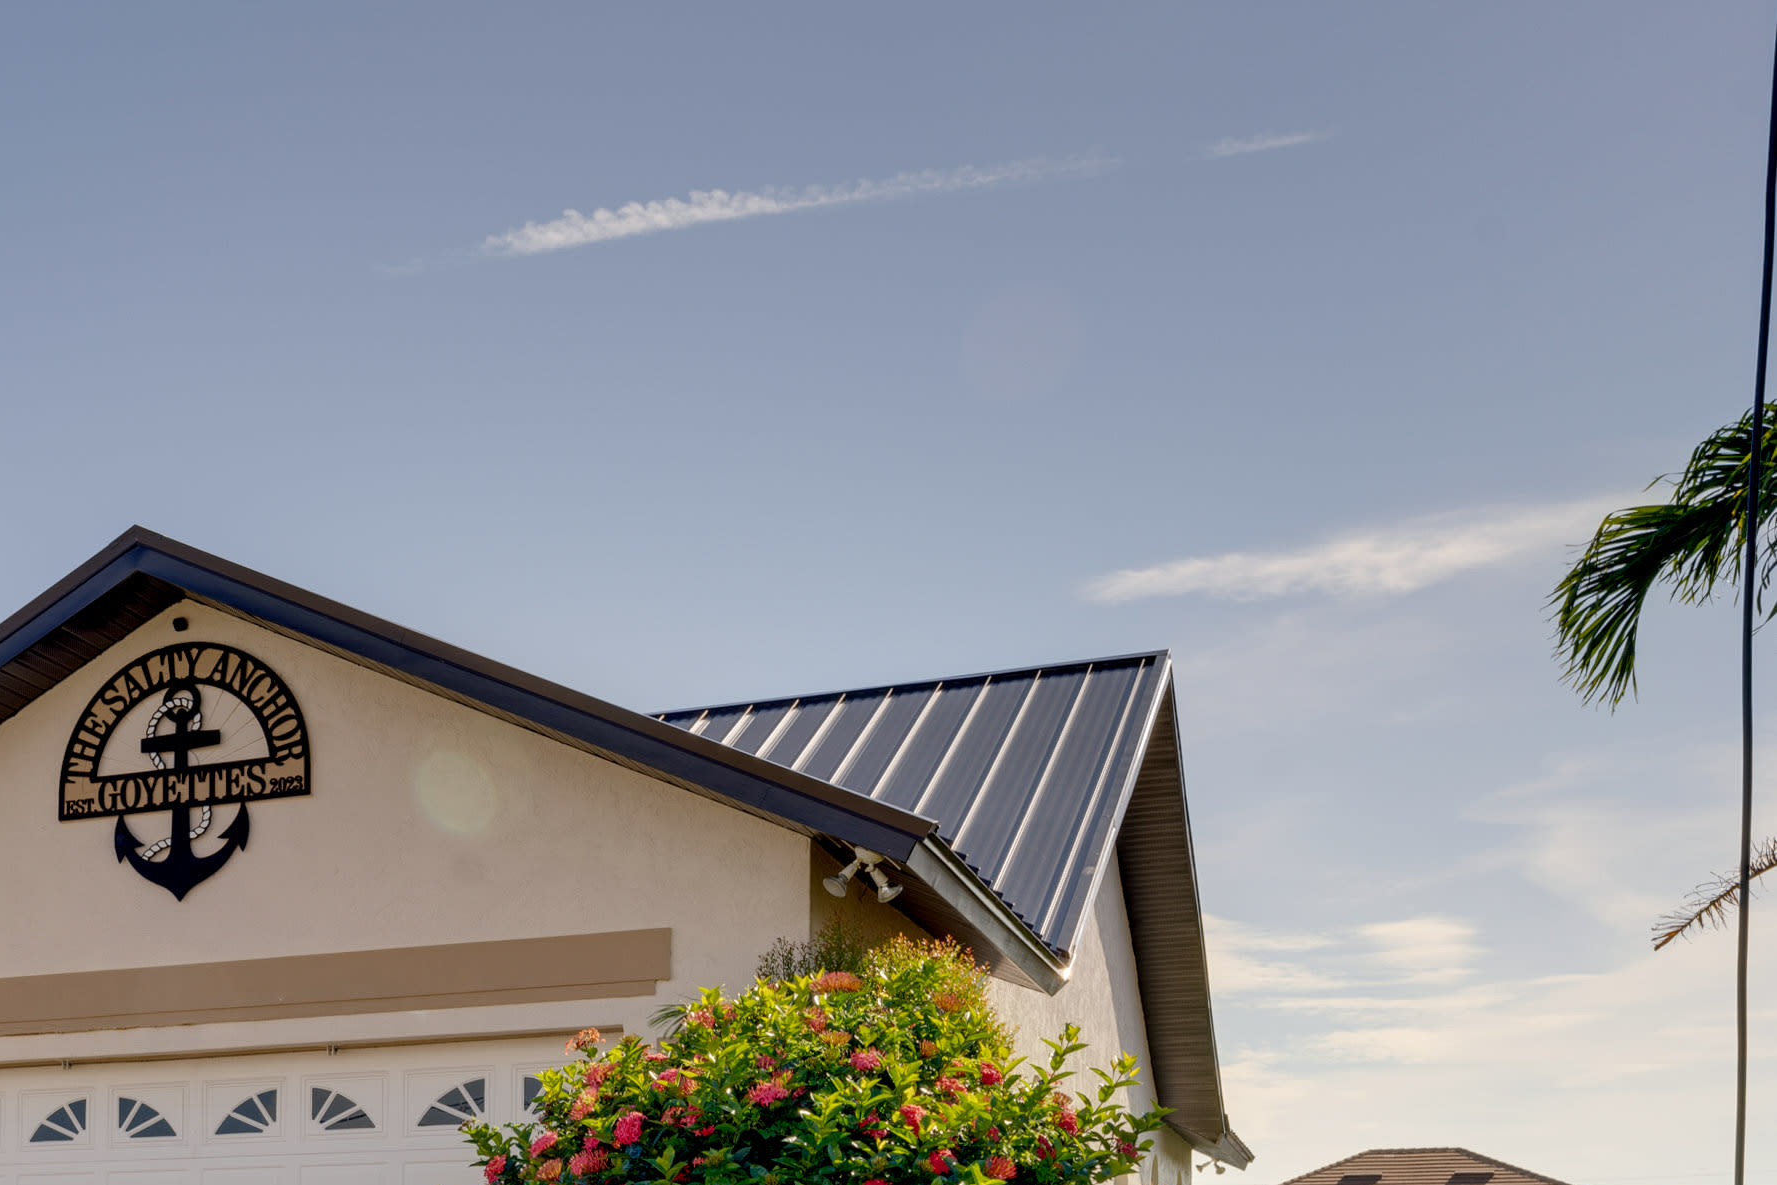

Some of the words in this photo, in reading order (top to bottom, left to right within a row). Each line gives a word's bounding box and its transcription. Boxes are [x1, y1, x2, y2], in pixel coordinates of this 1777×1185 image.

[66, 708, 116, 783] THE
[101, 649, 202, 713] SALTY
[208, 650, 304, 766] ANCHOR
[98, 764, 266, 811] GOYETTES
[269, 775, 303, 792] 2023
